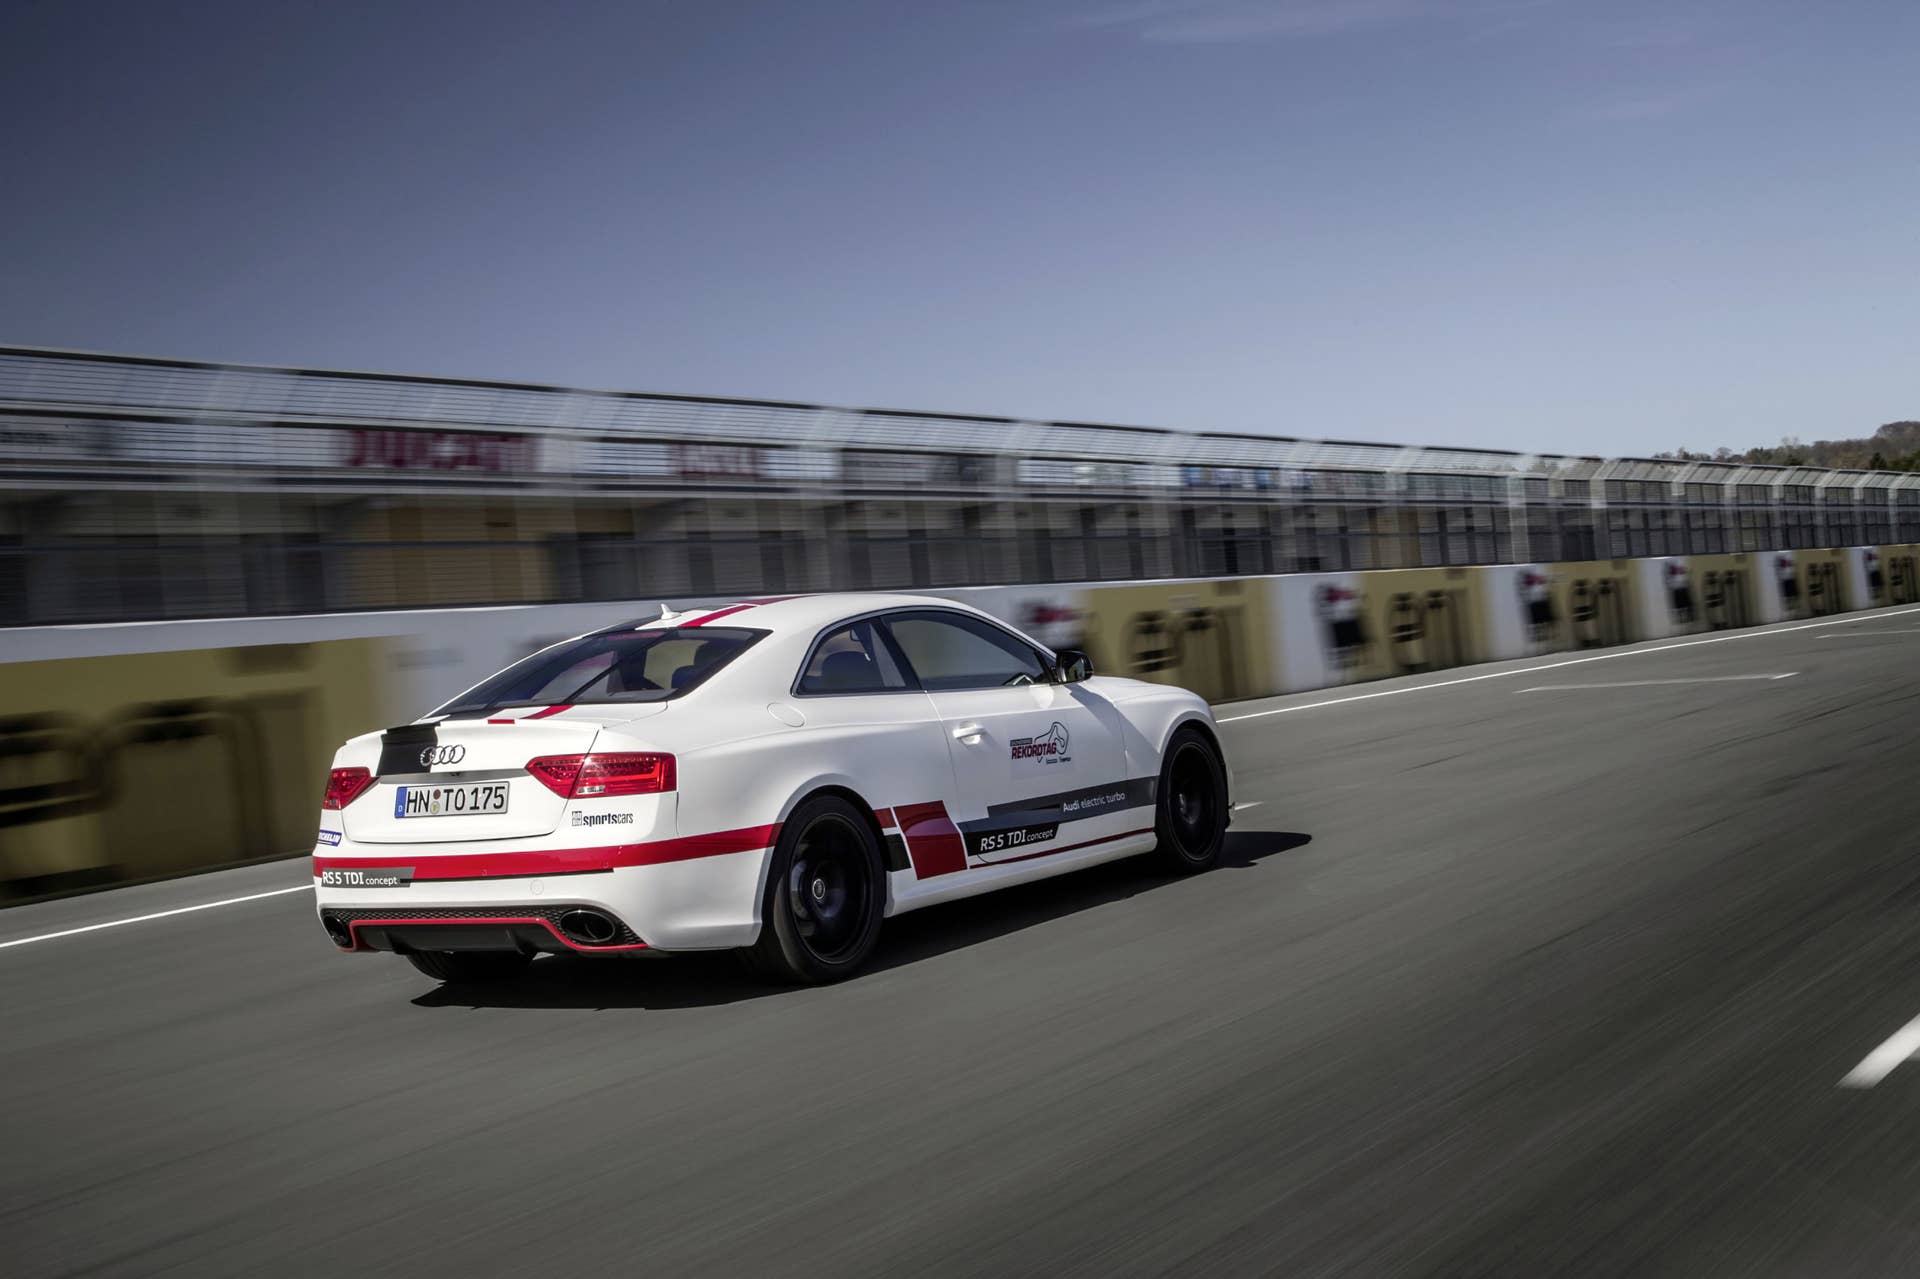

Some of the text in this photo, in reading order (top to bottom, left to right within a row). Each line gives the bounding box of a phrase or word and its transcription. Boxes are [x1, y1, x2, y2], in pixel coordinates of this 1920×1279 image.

[1011, 742, 1057, 760] REKORDTAG
[406, 786, 506, 813] HN TO 175
[1063, 792, 1126, 812] Audi electric turbo
[583, 813, 634, 827] sportscars
[1006, 829, 1026, 846] TDI
[1026, 829, 1054, 842] concept
[343, 871, 365, 885] TDI
[365, 876, 398, 886] concept
